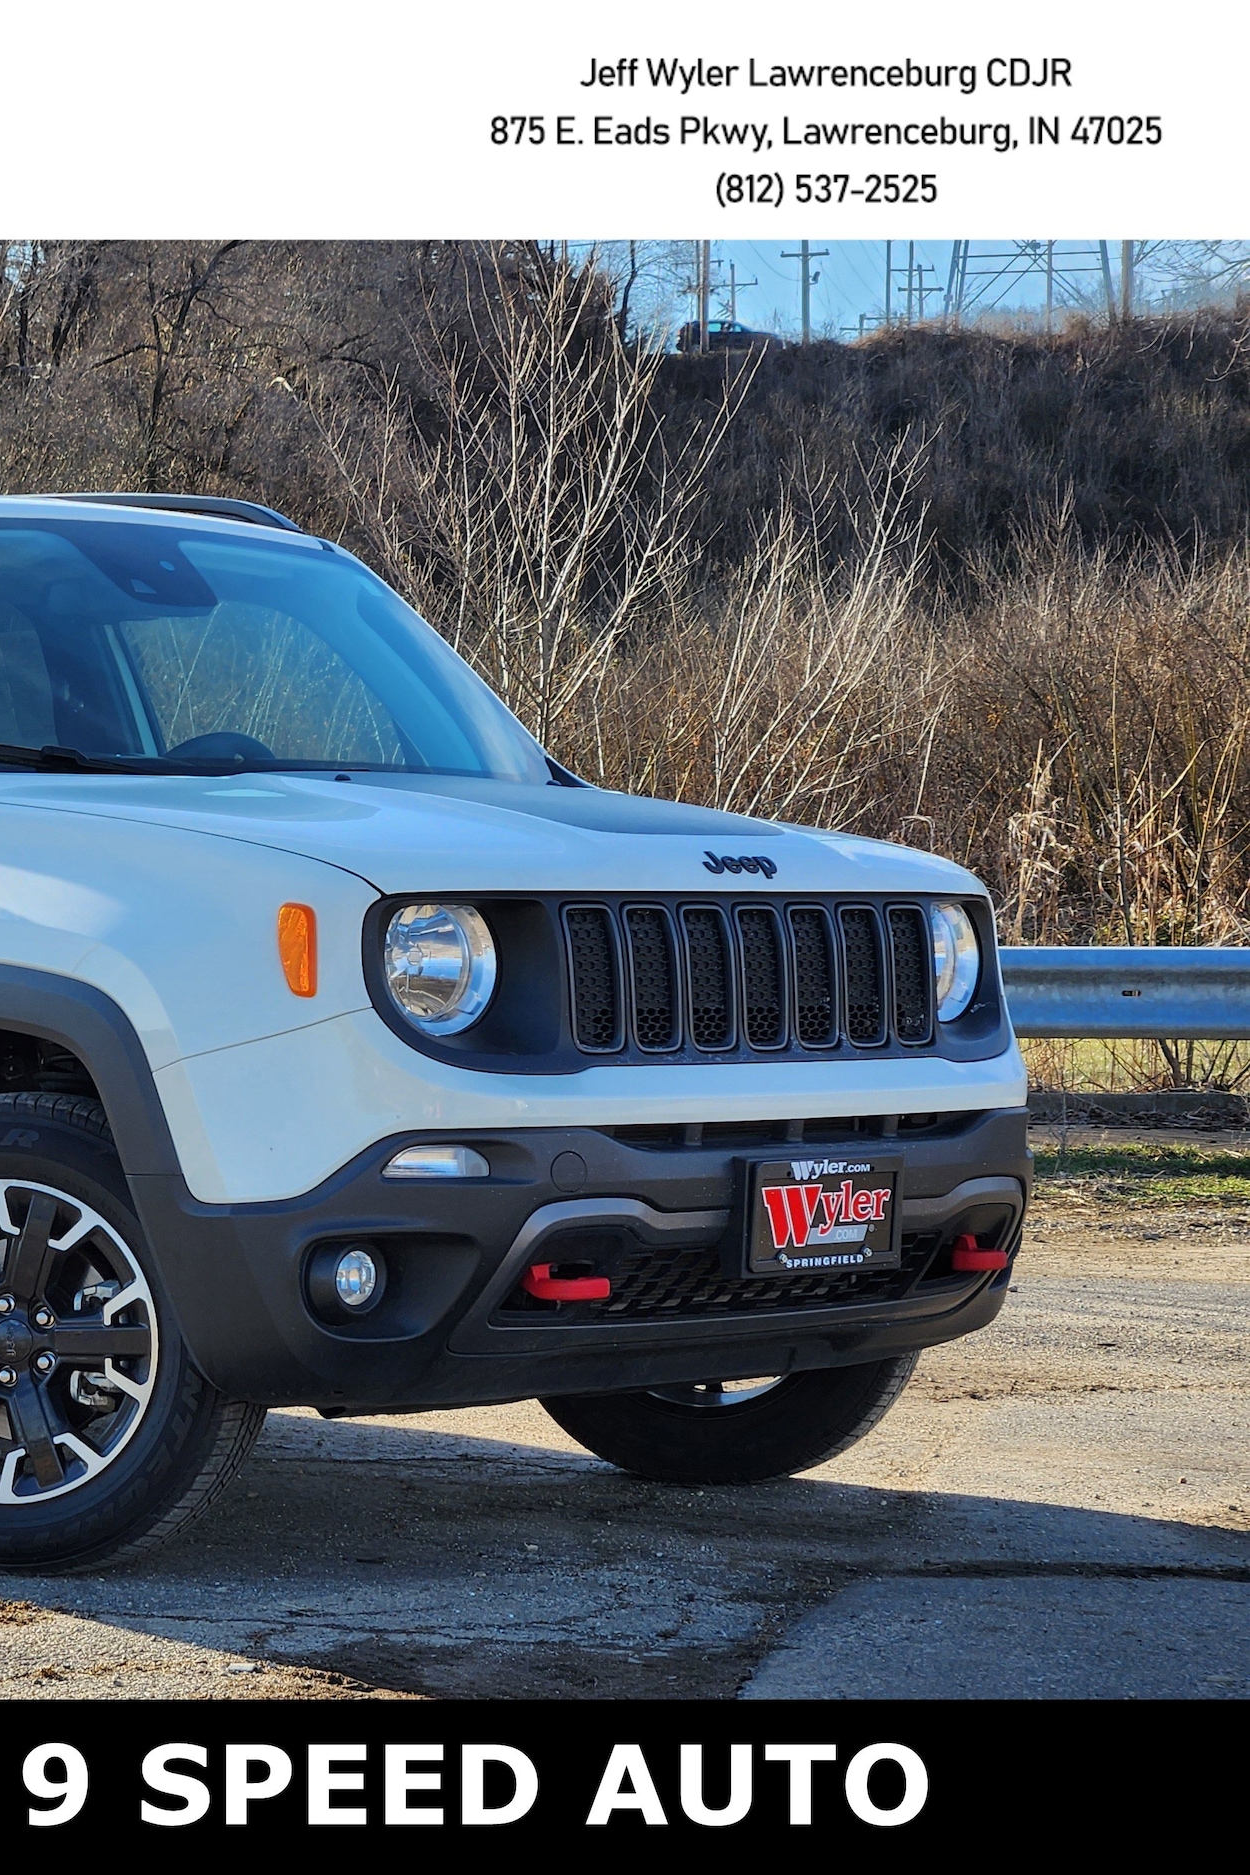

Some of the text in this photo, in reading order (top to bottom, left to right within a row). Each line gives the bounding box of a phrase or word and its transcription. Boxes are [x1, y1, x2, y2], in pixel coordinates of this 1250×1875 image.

[702, 850, 777, 879] Jeep
[761, 1180, 891, 1249] Wyler
[785, 1253, 864, 1269] SPRINGFIELD
